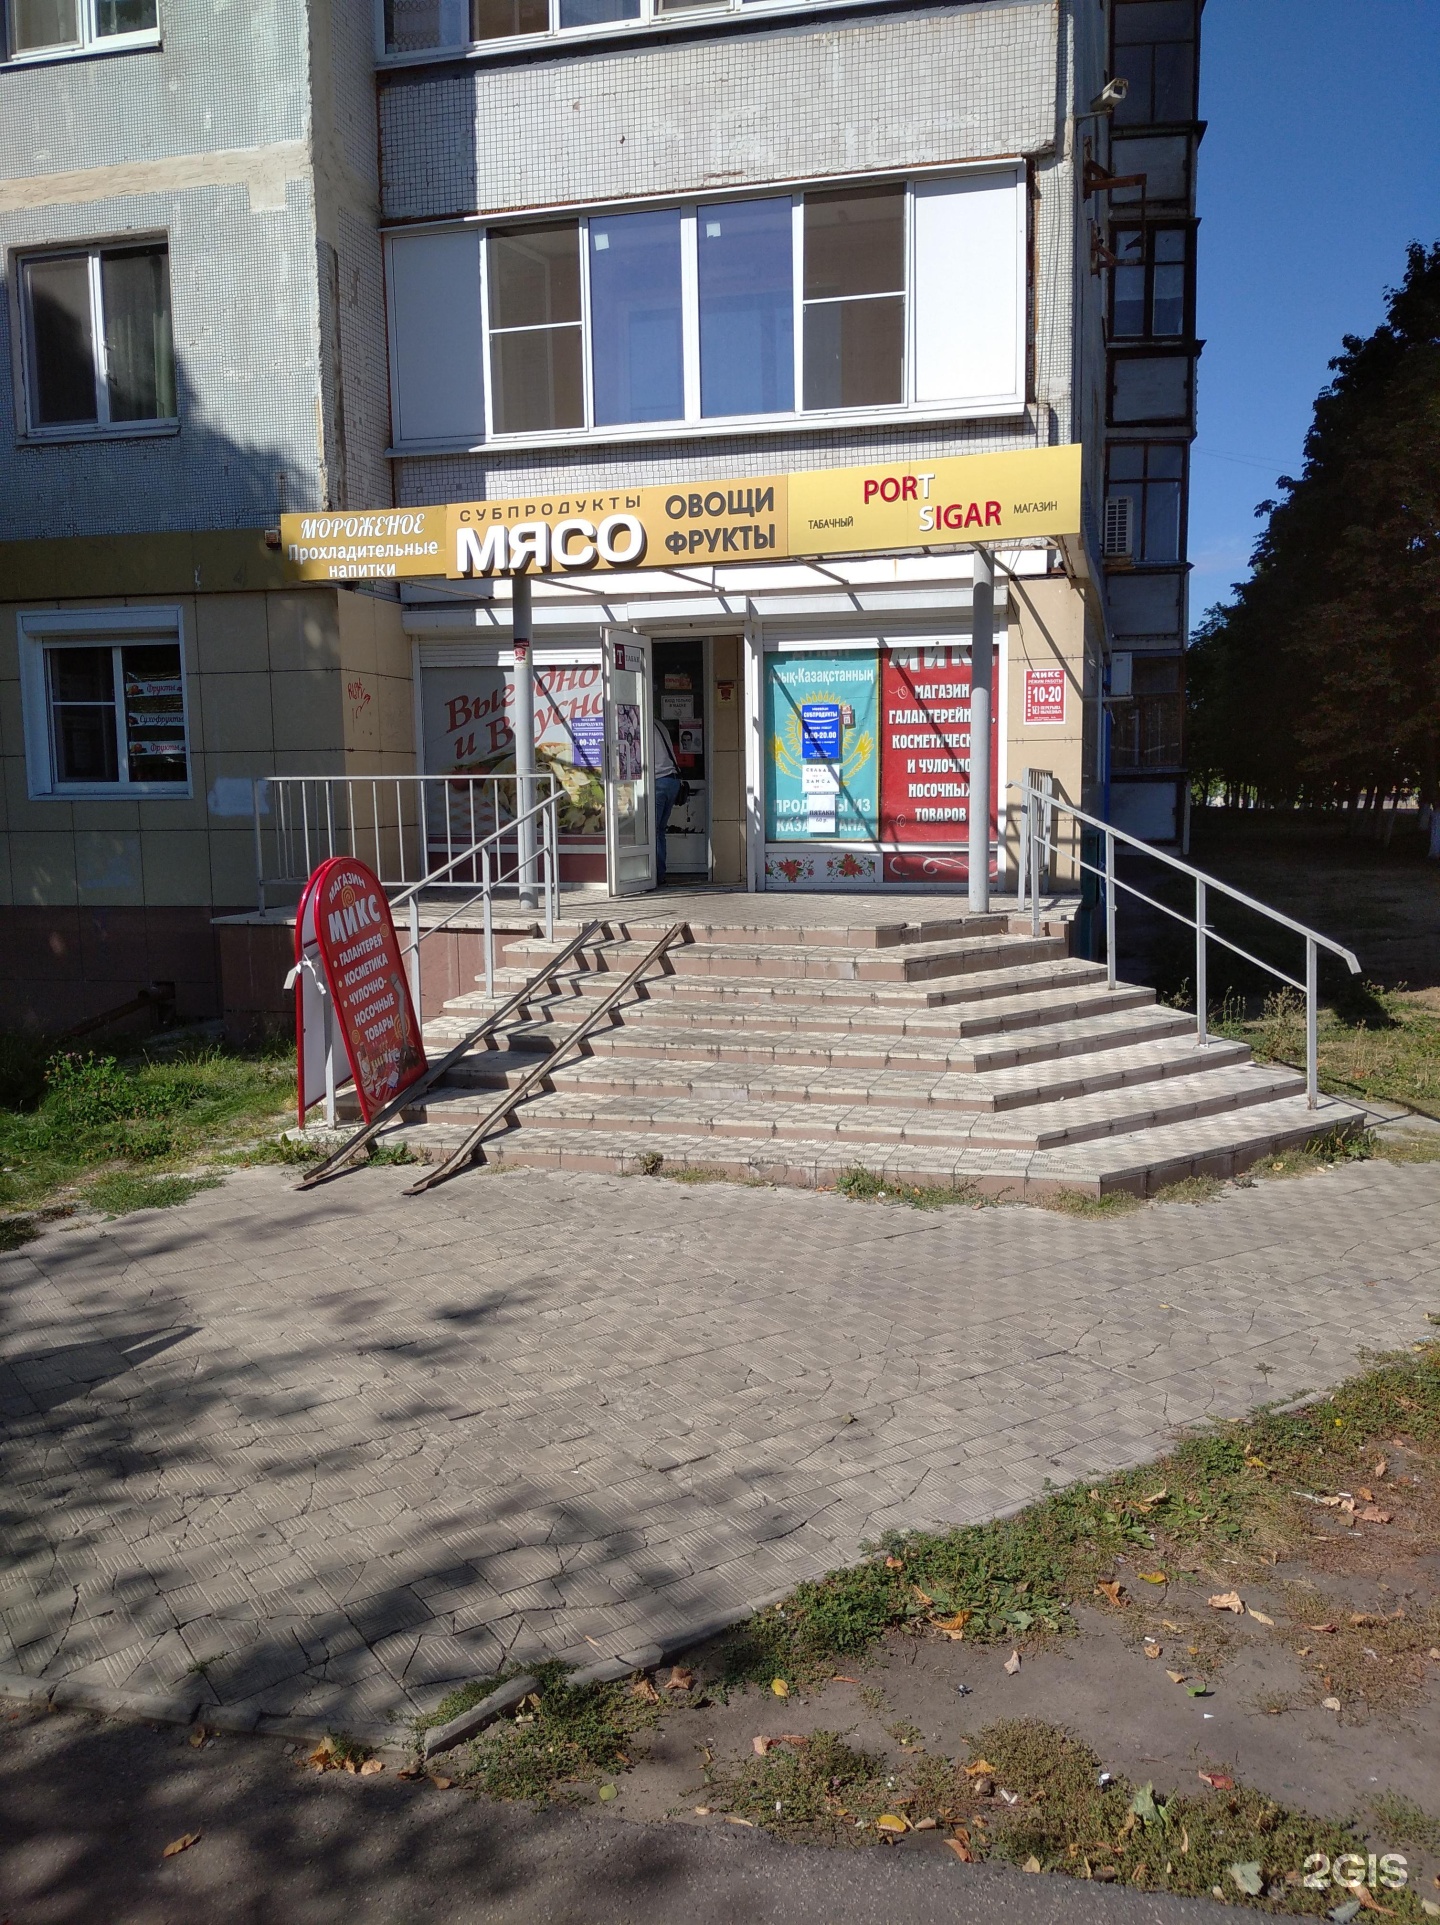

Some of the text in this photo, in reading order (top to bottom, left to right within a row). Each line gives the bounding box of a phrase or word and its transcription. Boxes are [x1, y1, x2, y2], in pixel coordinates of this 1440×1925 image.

[665, 486, 775, 520] ОВОЩИ
[863, 473, 936, 505] PORT
[459, 495, 642, 523] СУБПРОДУКТЫ
[919, 500, 1002, 532] SIGAR
[1013, 500, 1058, 515] МАГАЗИН
[300, 513, 425, 540] МОРОЖЕНОЕ
[808, 515, 854, 531] ТАБАЧНЫЙ
[288, 540, 438, 562] Прохладительные
[456, 513, 648, 574] МЯСО
[665, 524, 776, 555] ФРУКТЫ
[328, 562, 396, 579] напитки
[889, 646, 996, 673] МИК
[444, 664, 600, 734] Выгдно
[914, 684, 970, 699] МАГАЗИН
[1033, 686, 1062, 703] 10-20
[454, 691, 604, 760] и Вусно
[907, 759, 916, 773] И
[775, 798, 871, 815] ПРОДЫ ИЗ
[914, 807, 967, 822] ТОВАРОВ
[328, 872, 367, 905] МАГАЗИН
[327, 893, 382, 944] МИКС
[338, 932, 384, 967] ГАЛАНТЕРЕЯ
[343, 953, 388, 986] КОСМЕТИКА
[354, 993, 395, 1028] НОСОЧНЫЕ
[364, 1014, 395, 1043] ТОВАРЫ
